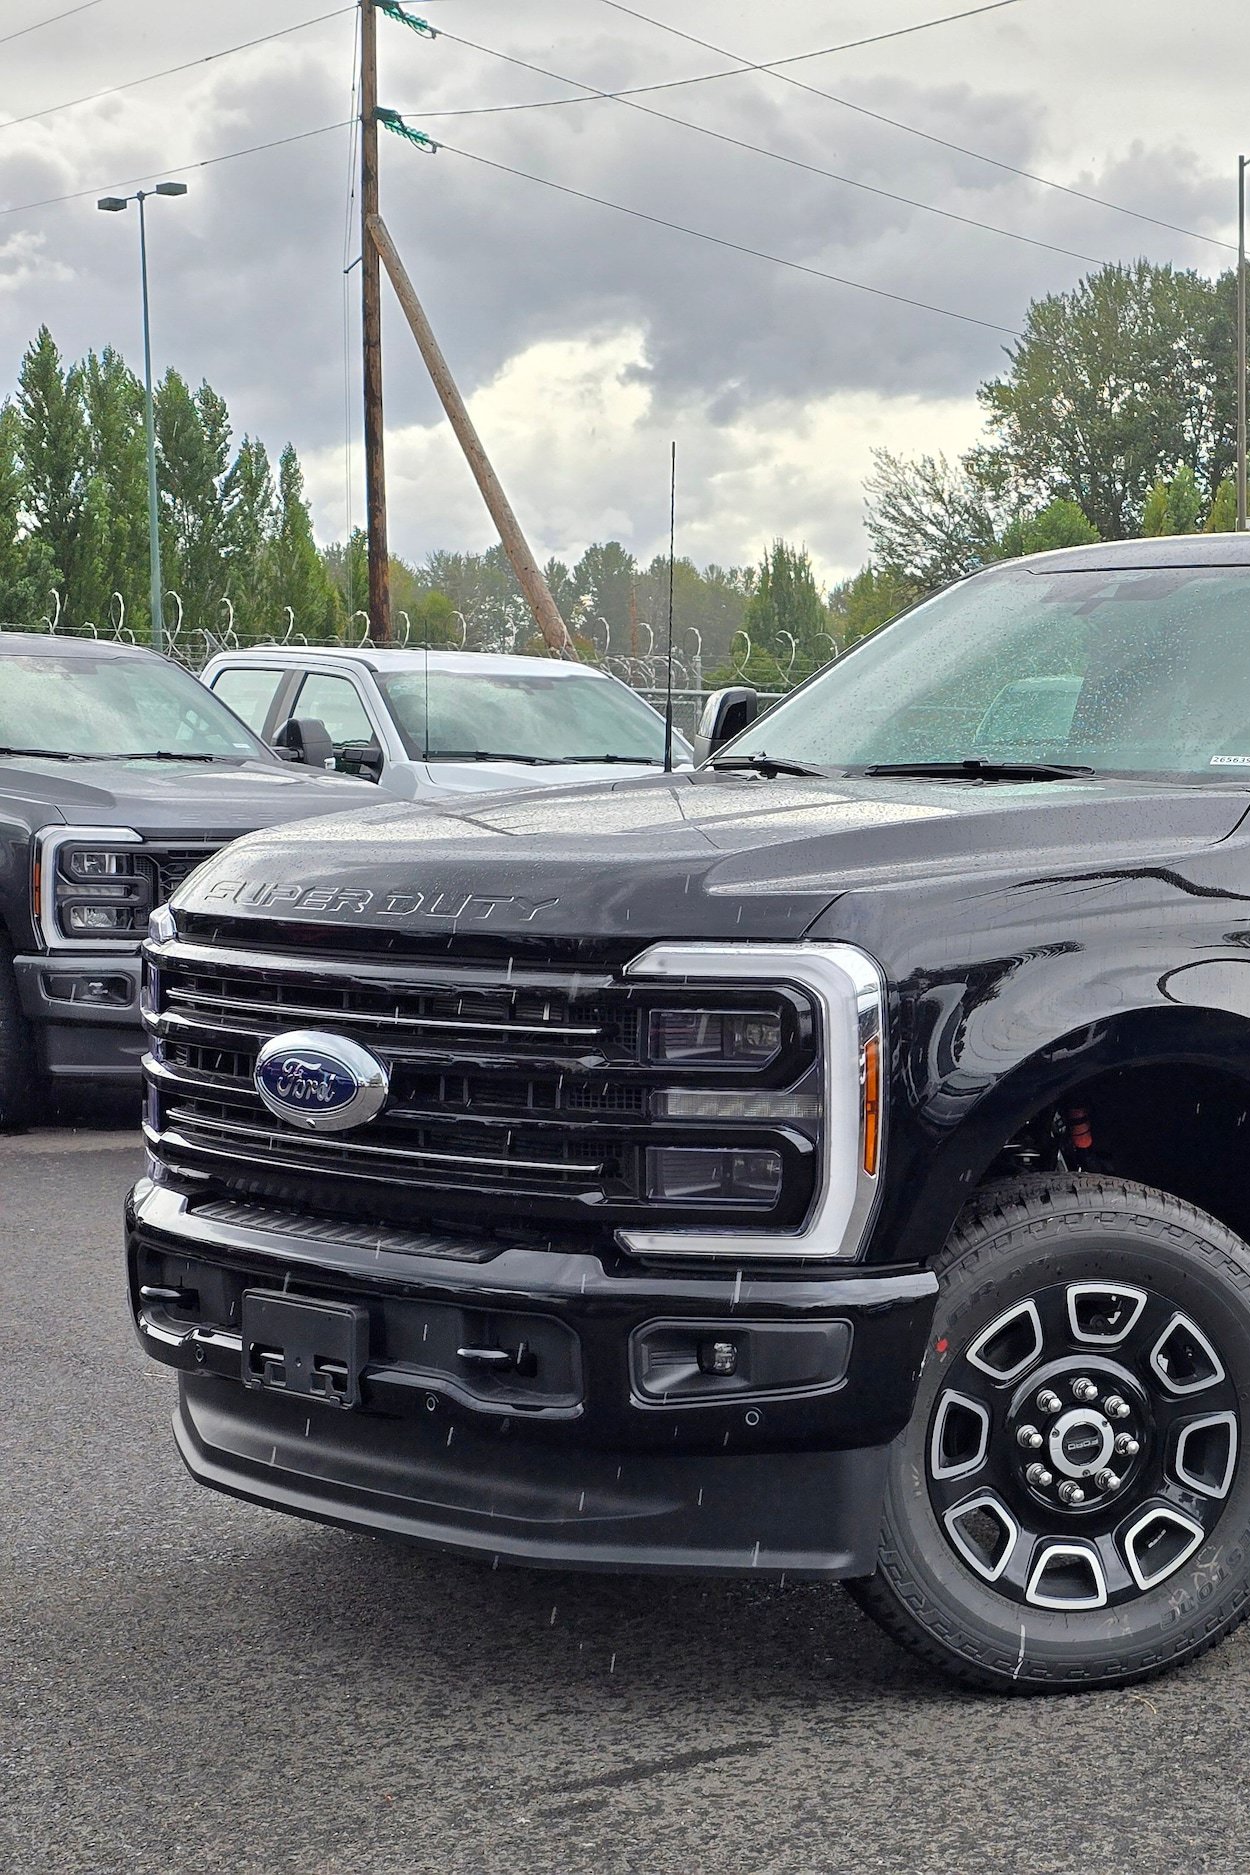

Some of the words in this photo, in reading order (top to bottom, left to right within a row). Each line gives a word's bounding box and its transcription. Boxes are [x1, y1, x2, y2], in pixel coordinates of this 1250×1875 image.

[204, 880, 374, 914] SUPER
[376, 891, 560, 921] DUTY
[276, 1057, 336, 1103] Ford
[1066, 1436, 1100, 1451] FORD
